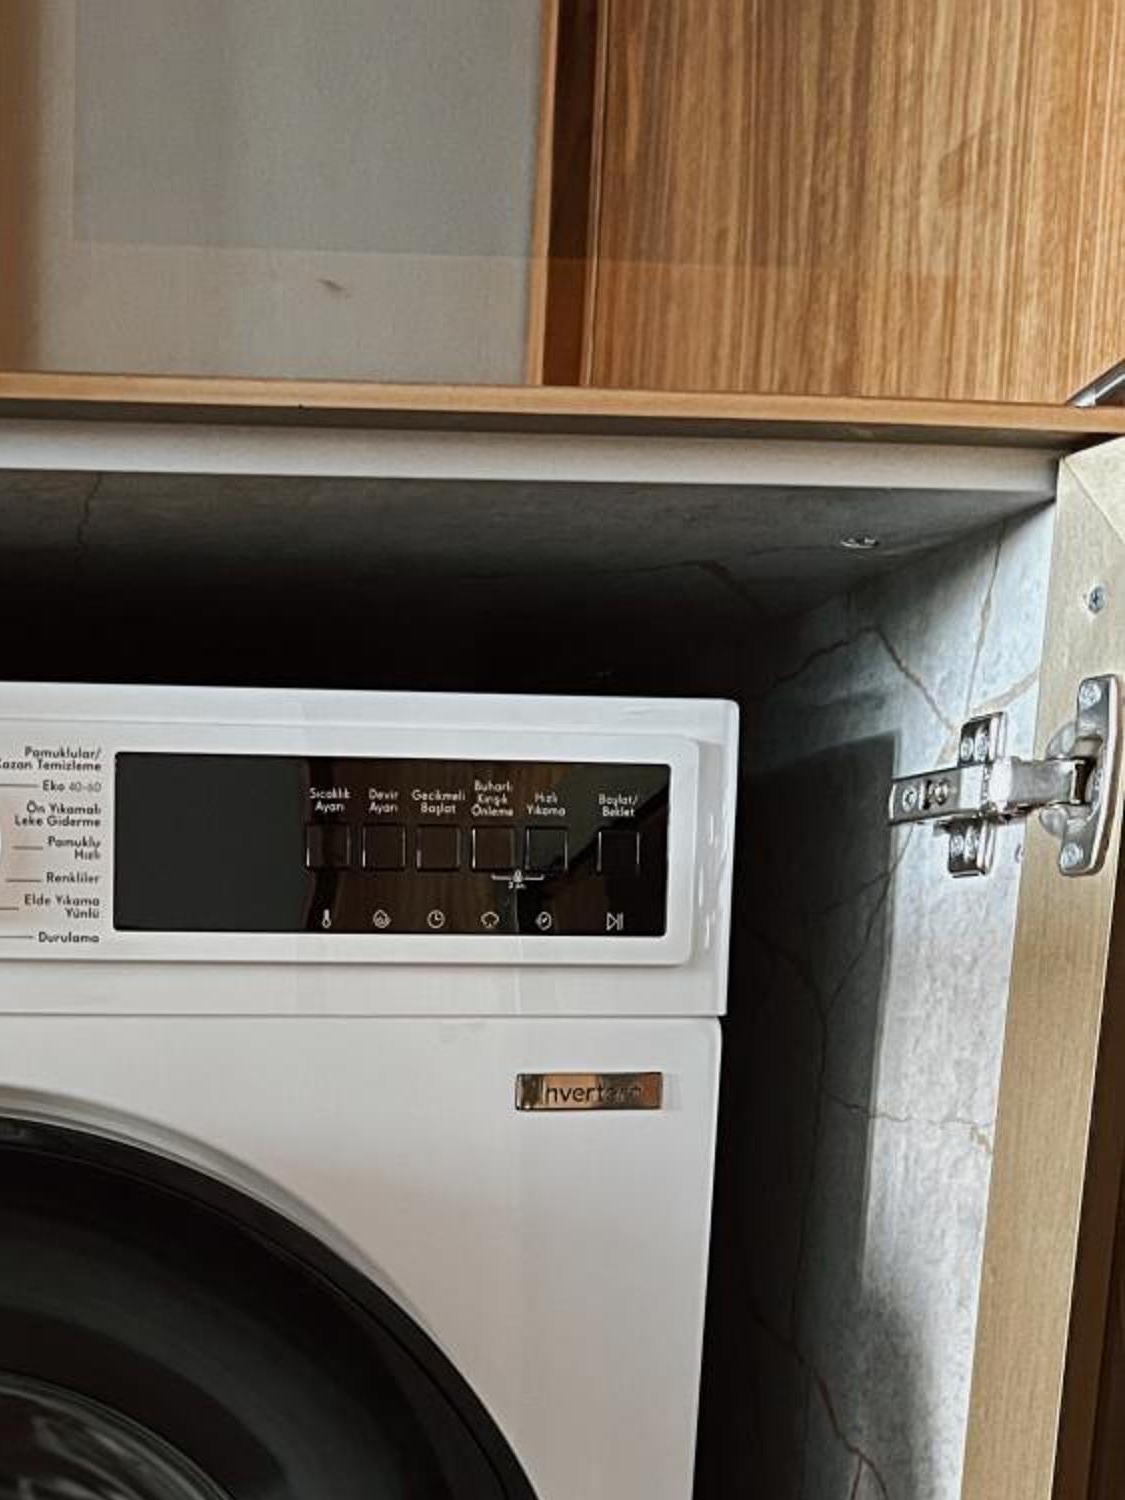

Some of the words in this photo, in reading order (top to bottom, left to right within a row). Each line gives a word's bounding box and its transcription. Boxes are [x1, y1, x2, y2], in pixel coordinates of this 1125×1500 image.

[24, 746, 101, 760] Pamuklular/
[38, 759, 101, 771] Temizleme
[42, 781, 65, 791] Eko
[309, 787, 351, 799] Sıcaklık
[368, 788, 399, 800] Devir
[411, 789, 466, 801] Gecikmeli
[27, 800, 45, 813] Ön
[49, 803, 101, 814] Yıkamalı
[420, 802, 457, 816] Başlat
[471, 803, 514, 817] Önleme
[526, 804, 566, 817] Yıkama
[602, 805, 635, 818] Beklet
[15, 815, 43, 826] Leke
[47, 815, 101, 826] Giderme
[46, 872, 100, 884] Renkliler
[24, 894, 51, 906] Elde
[56, 894, 100, 906] Yıkama
[65, 907, 100, 919] Yünlü
[38, 931, 100, 943] Durulama
